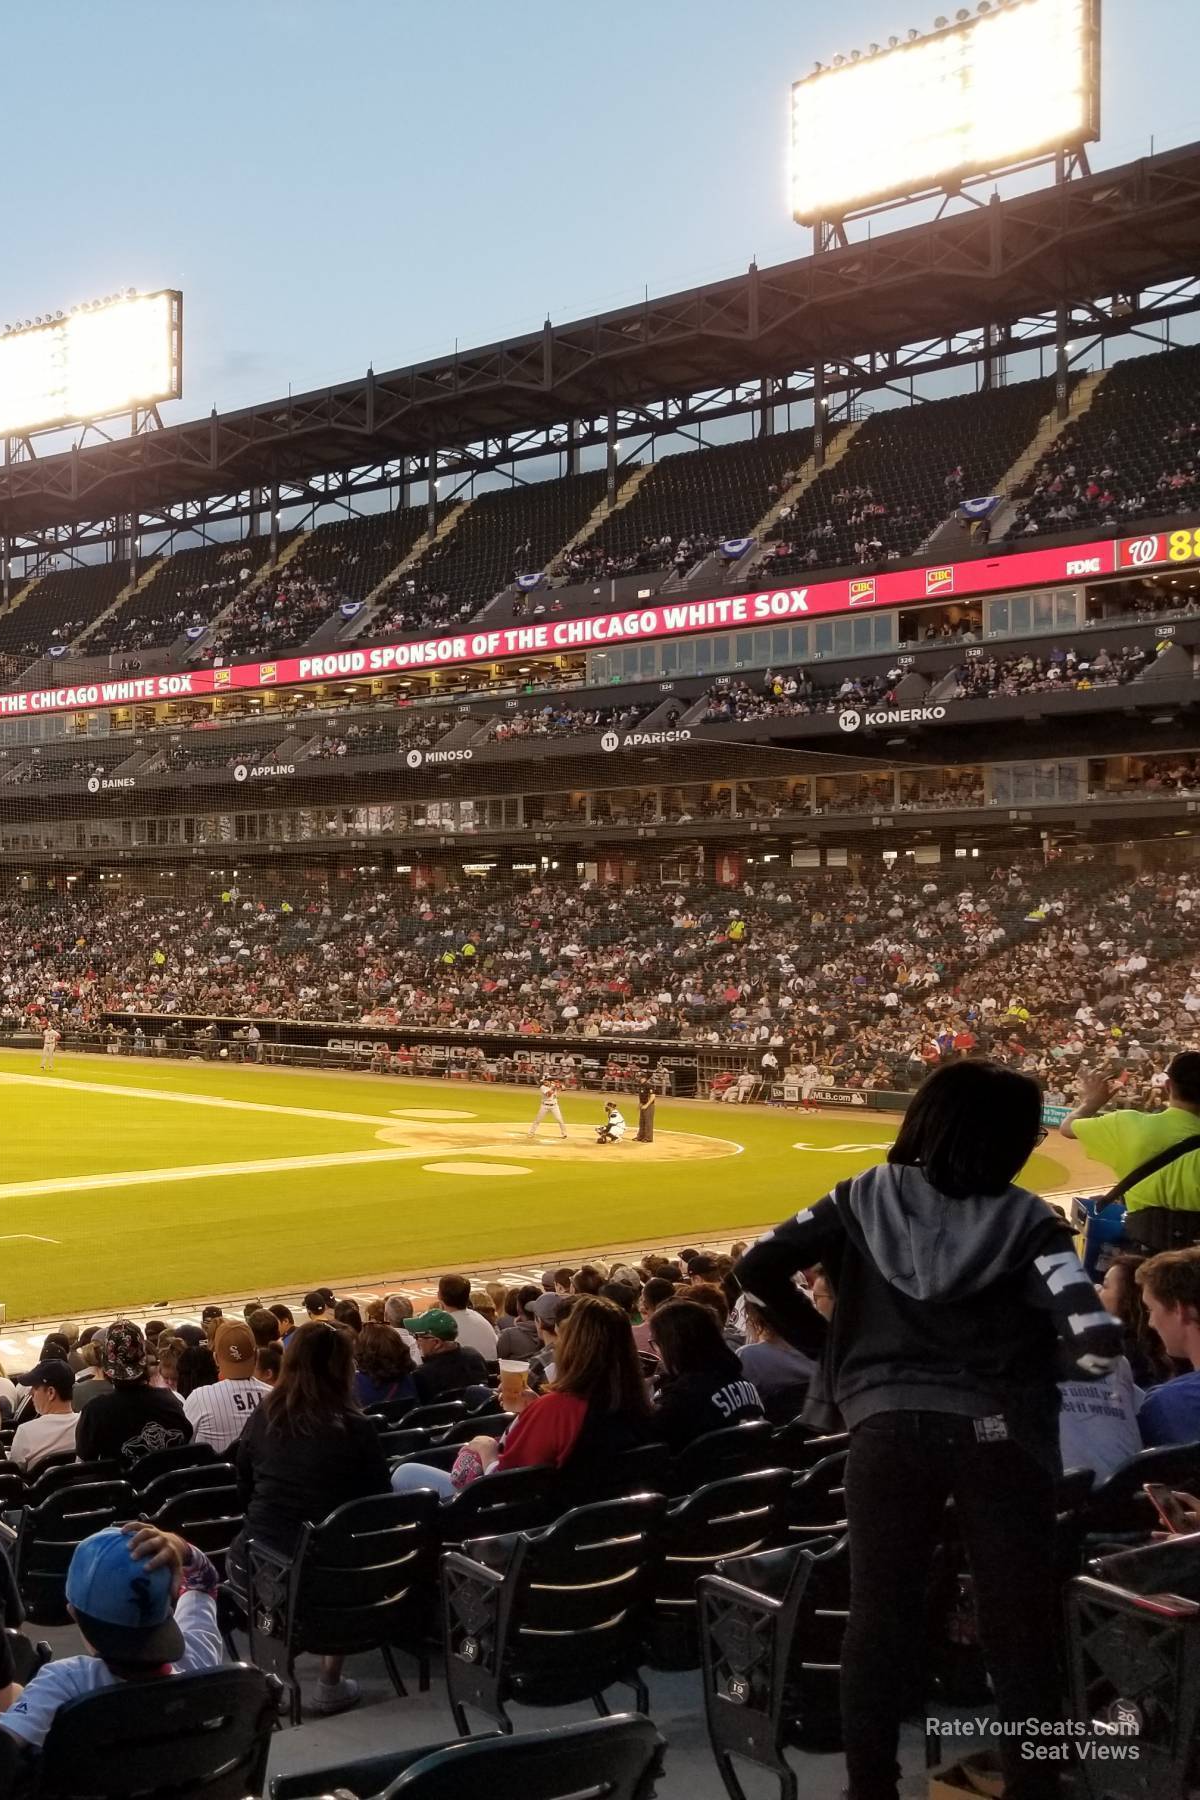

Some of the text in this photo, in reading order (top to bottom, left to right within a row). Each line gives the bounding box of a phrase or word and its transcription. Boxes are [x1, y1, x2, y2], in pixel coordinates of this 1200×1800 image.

[1169, 529, 1200, 561] 8
[1066, 558, 1100, 576] FDIC
[299, 588, 808, 678] PROUD SPONSOR OF THE CHICAGO WHITE SOX
[0, 693, 28, 712] THE
[30, 685, 98, 708] CHICAGO
[102, 678, 155, 701] WHITE
[158, 674, 193, 695] SOX
[841, 706, 946, 727] 14 KONERKO
[623, 730, 691, 746] APARICIO
[425, 750, 473, 763] MINOSO
[250, 764, 295, 777] APPLING
[101, 778, 135, 789] BAINES
[328, 1038, 389, 1056] GEICO
[513, 1050, 585, 1067] GEICO
[608, 1053, 650, 1064] GEICO
[813, 1092, 851, 1102] MLB.com
[1117, 1710, 1136, 1723] 20
